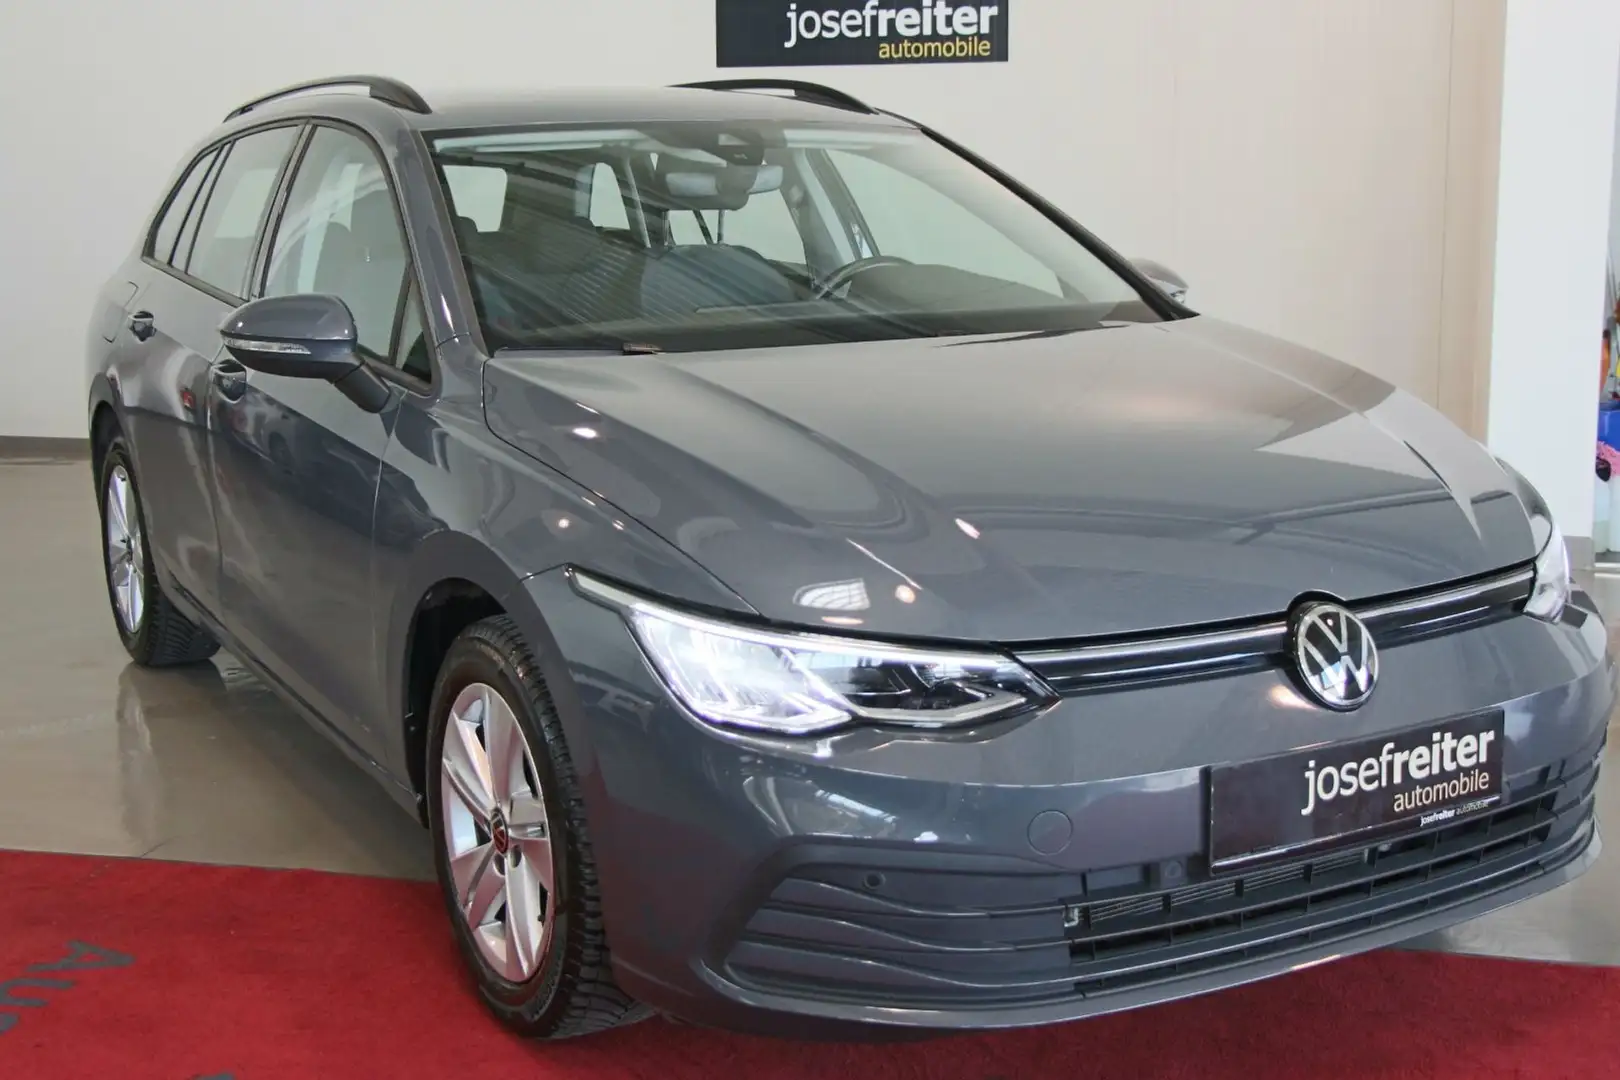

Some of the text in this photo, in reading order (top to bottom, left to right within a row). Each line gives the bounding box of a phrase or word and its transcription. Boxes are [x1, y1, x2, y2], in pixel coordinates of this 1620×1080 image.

[784, 0, 998, 48] josefreiter
[879, 37, 991, 59] automobile
[1301, 730, 1495, 816] josefreiter
[1393, 769, 1490, 812] automobile
